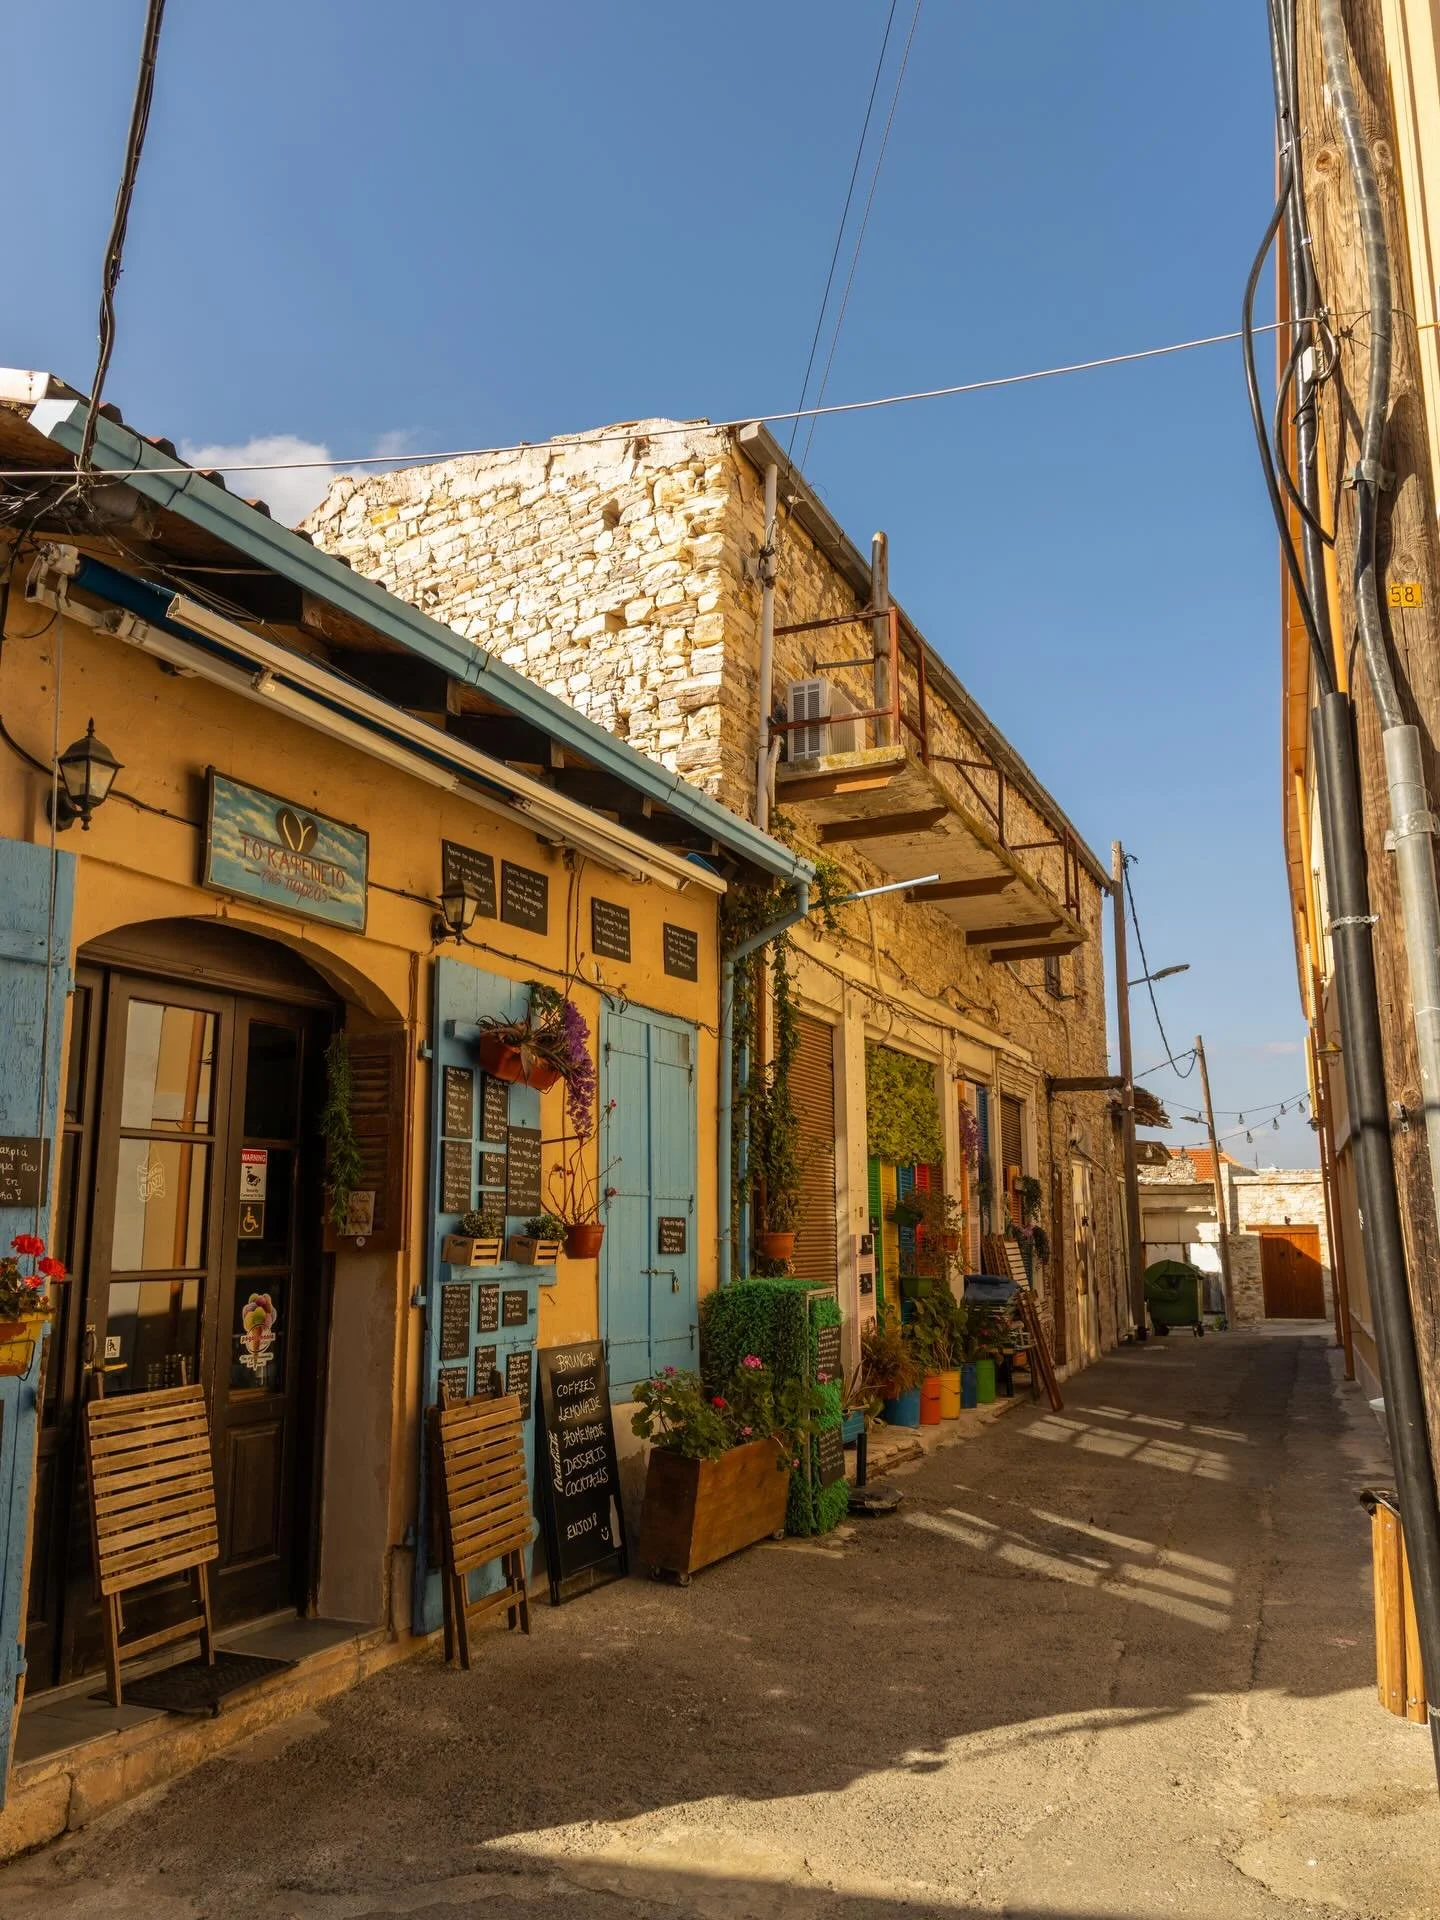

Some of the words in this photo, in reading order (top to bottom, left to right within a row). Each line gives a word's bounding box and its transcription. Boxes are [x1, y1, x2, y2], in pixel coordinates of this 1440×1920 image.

[1391, 586, 1414, 603] 58
[0, 1144, 28, 1161] ακριά
[242, 1153, 266, 1162] WARNING
[556, 1351, 597, 1374] BRUNCH
[556, 1377, 596, 1398] COFFEES
[558, 1396, 602, 1422] LEMONADE
[562, 1423, 607, 1449] HOMEMADE
[563, 1446, 607, 1476] DESSERTS
[565, 1467, 609, 1497] COCKTAILS
